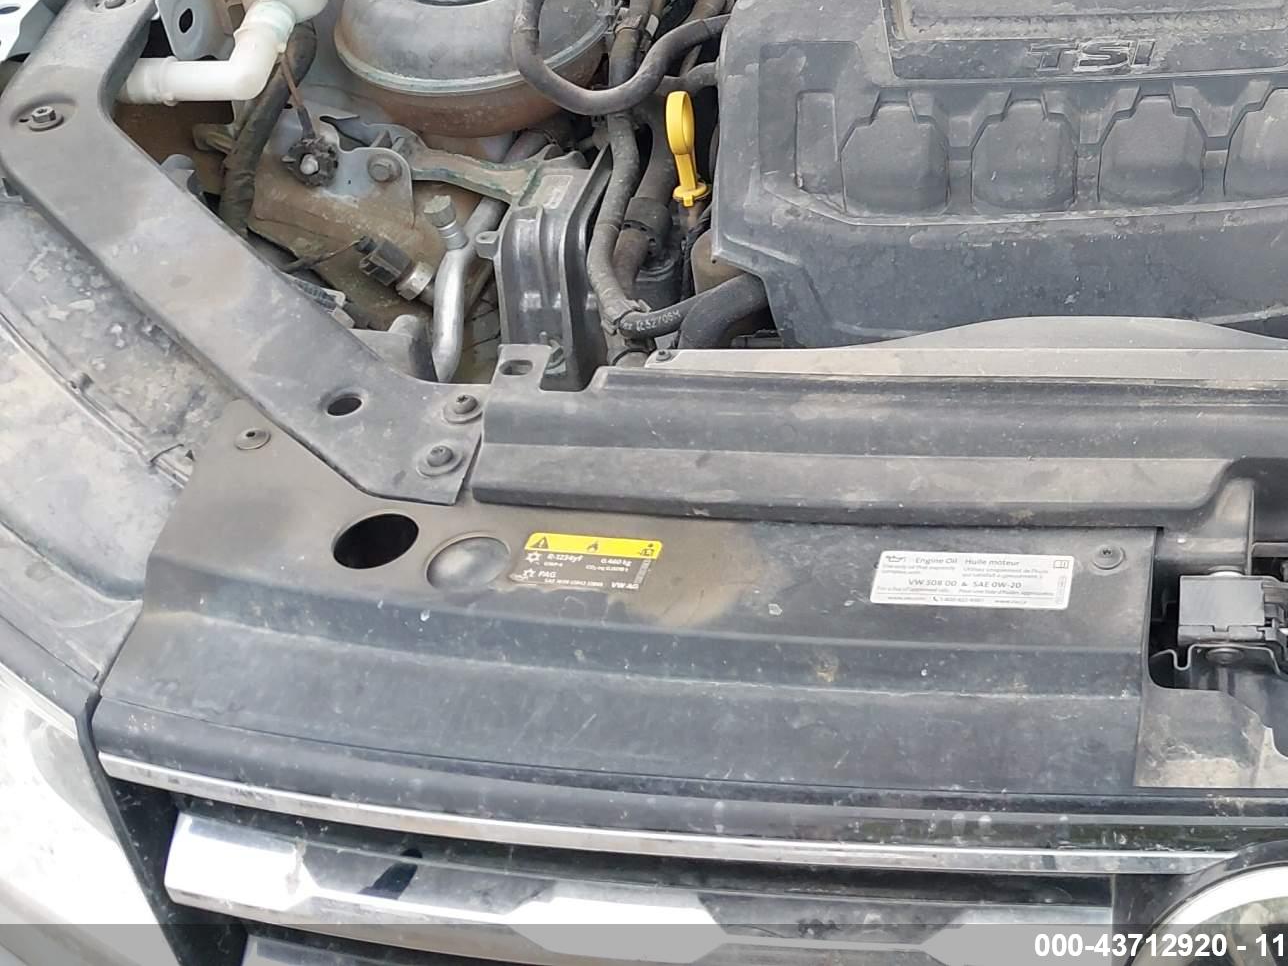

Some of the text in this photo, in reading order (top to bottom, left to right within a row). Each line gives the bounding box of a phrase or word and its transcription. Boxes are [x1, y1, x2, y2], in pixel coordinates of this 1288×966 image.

[1028, 38, 1156, 72] TSI
[915, 556, 944, 565] Engine
[965, 558, 1020, 567] Huile moteur
[909, 578, 924, 586] VW
[944, 579, 958, 587] 00
[972, 580, 990, 588] SAE
[991, 581, 1022, 589] 0W-20
